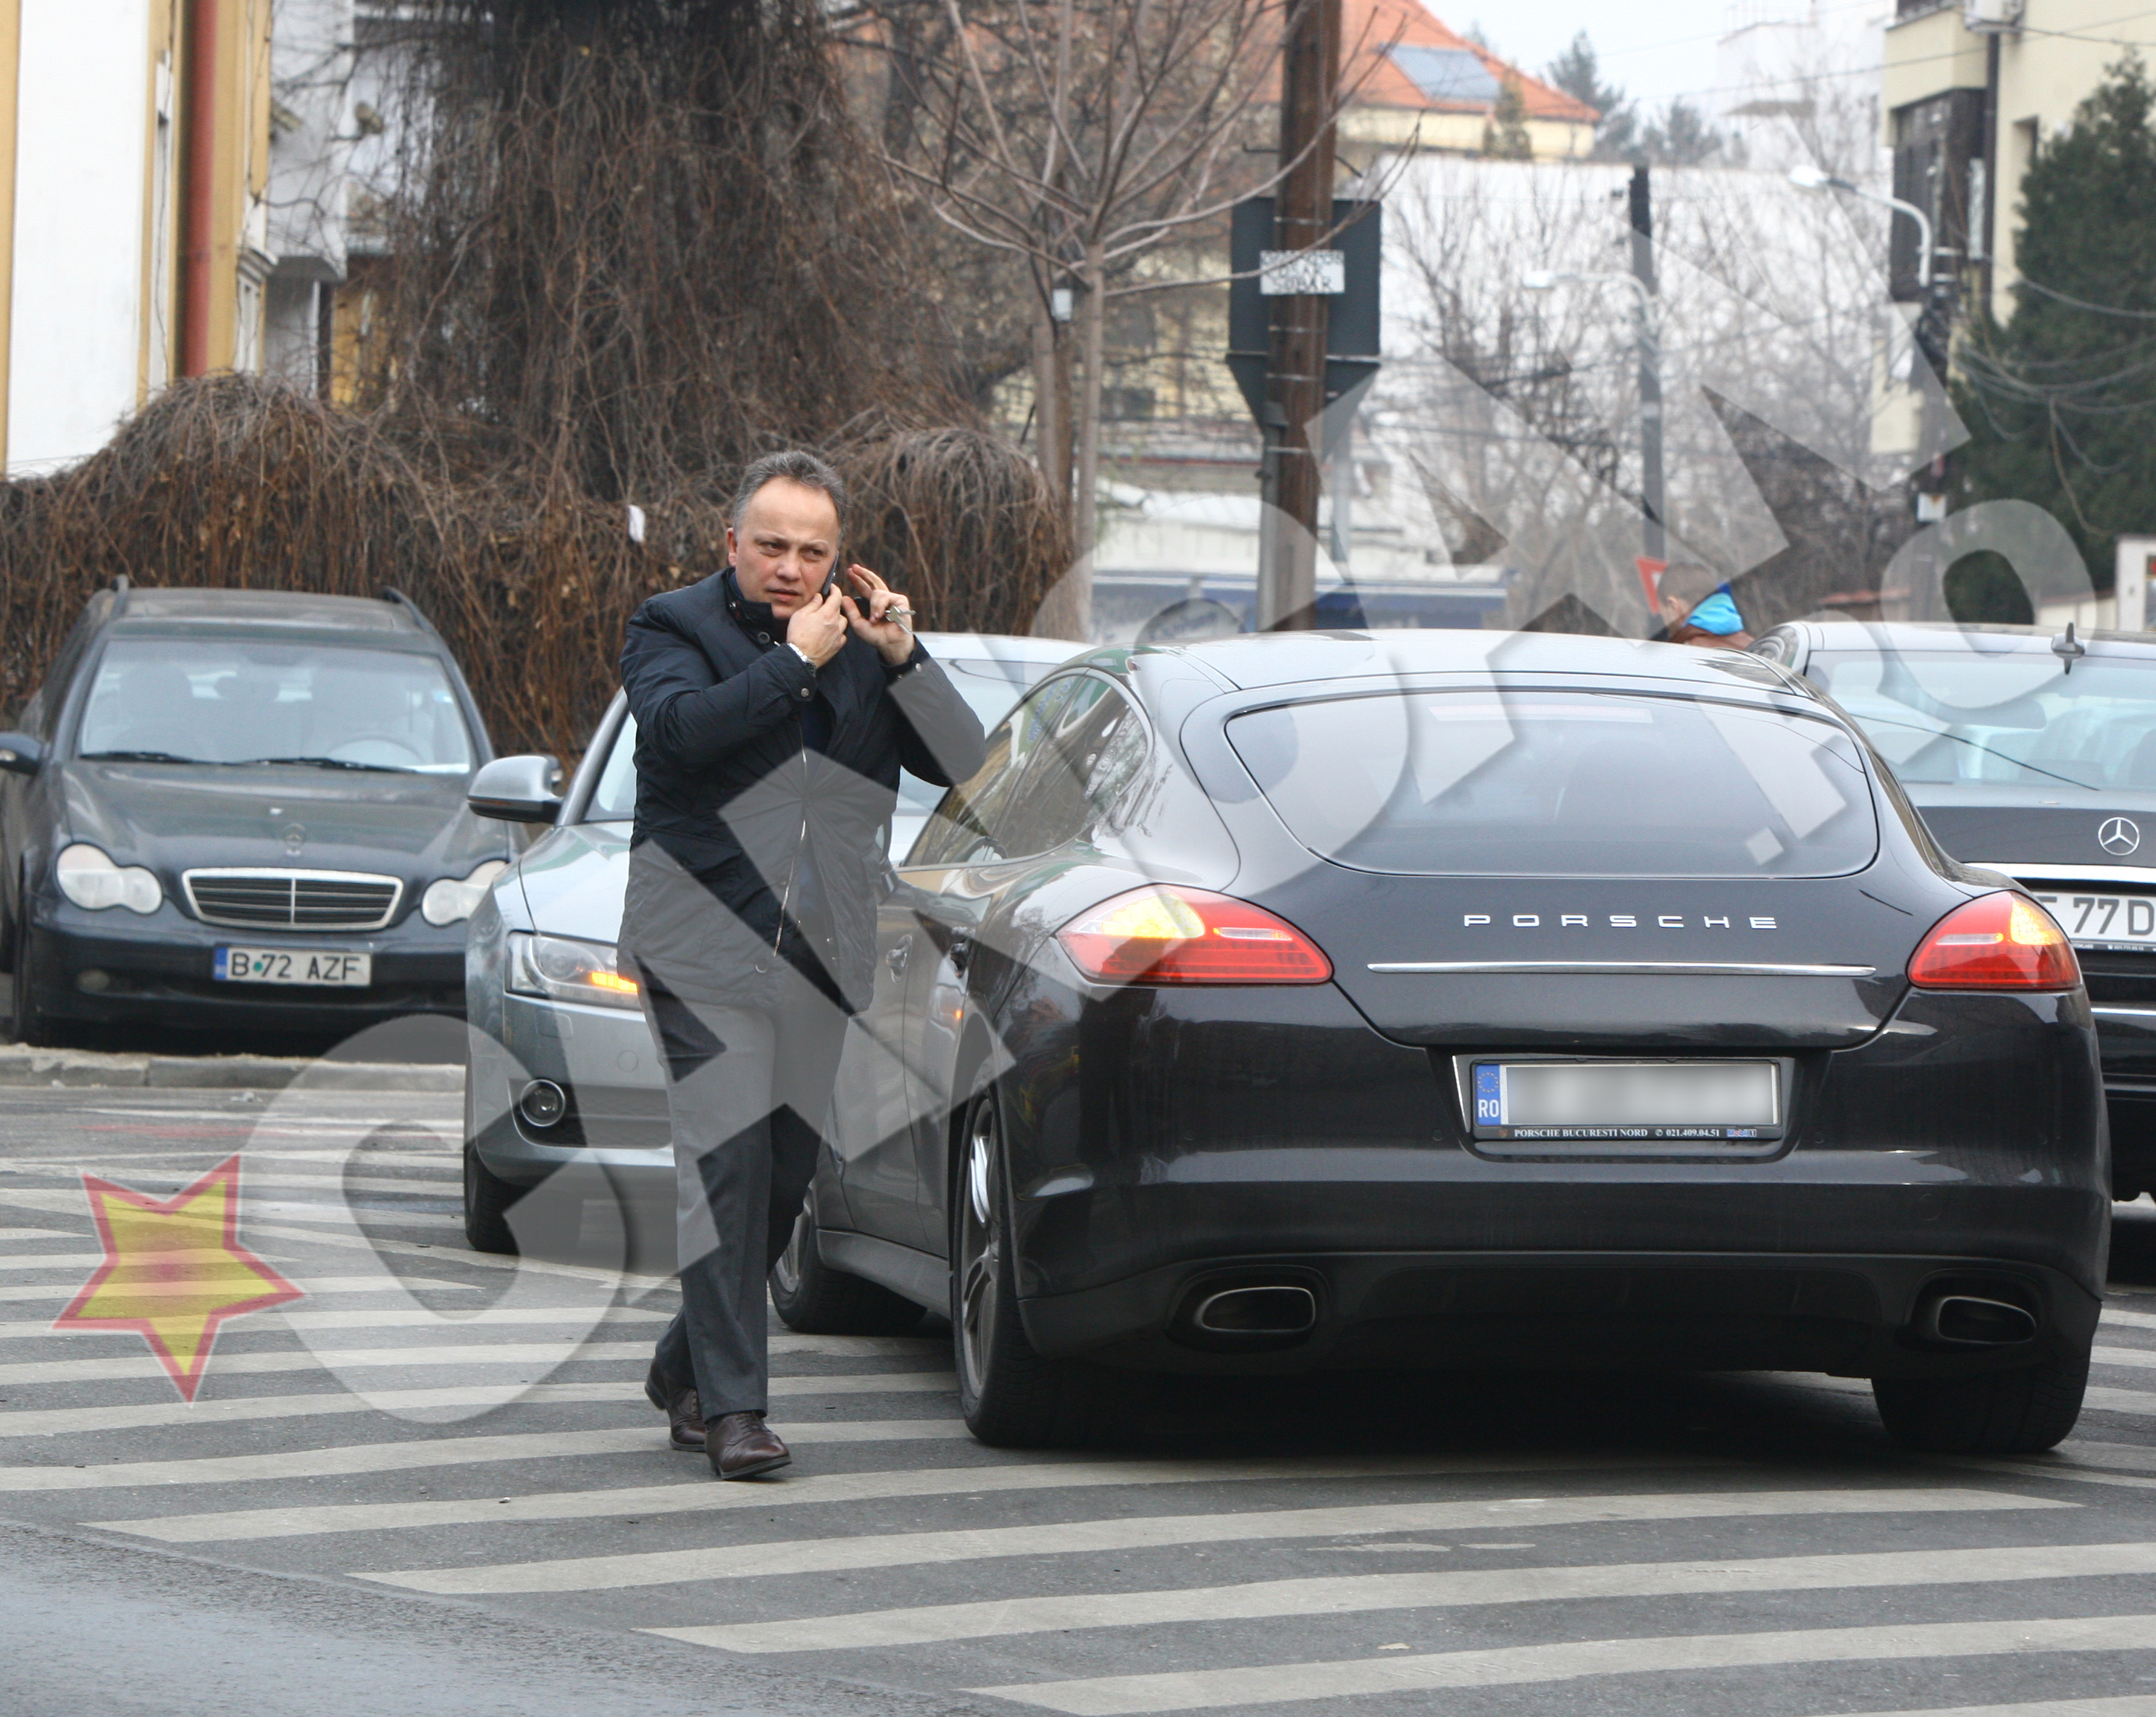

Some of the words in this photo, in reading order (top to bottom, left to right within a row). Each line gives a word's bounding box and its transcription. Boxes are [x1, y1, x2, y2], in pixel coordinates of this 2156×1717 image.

[1463, 914, 1777, 929] PORSCHE
[2073, 897, 2120, 935] 77
[2128, 899, 2155, 935] D
[231, 953, 250, 977] B
[261, 954, 292, 978] 72
[307, 956, 362, 981] AZF
[1478, 1098, 1500, 1119] RO
[1513, 1128, 1560, 1137] PORSCHE
[1562, 1128, 1618, 1137] BUCURESTI
[1619, 1128, 1648, 1137] NORD
[1666, 1128, 1721, 1137] 021.409.04.51
